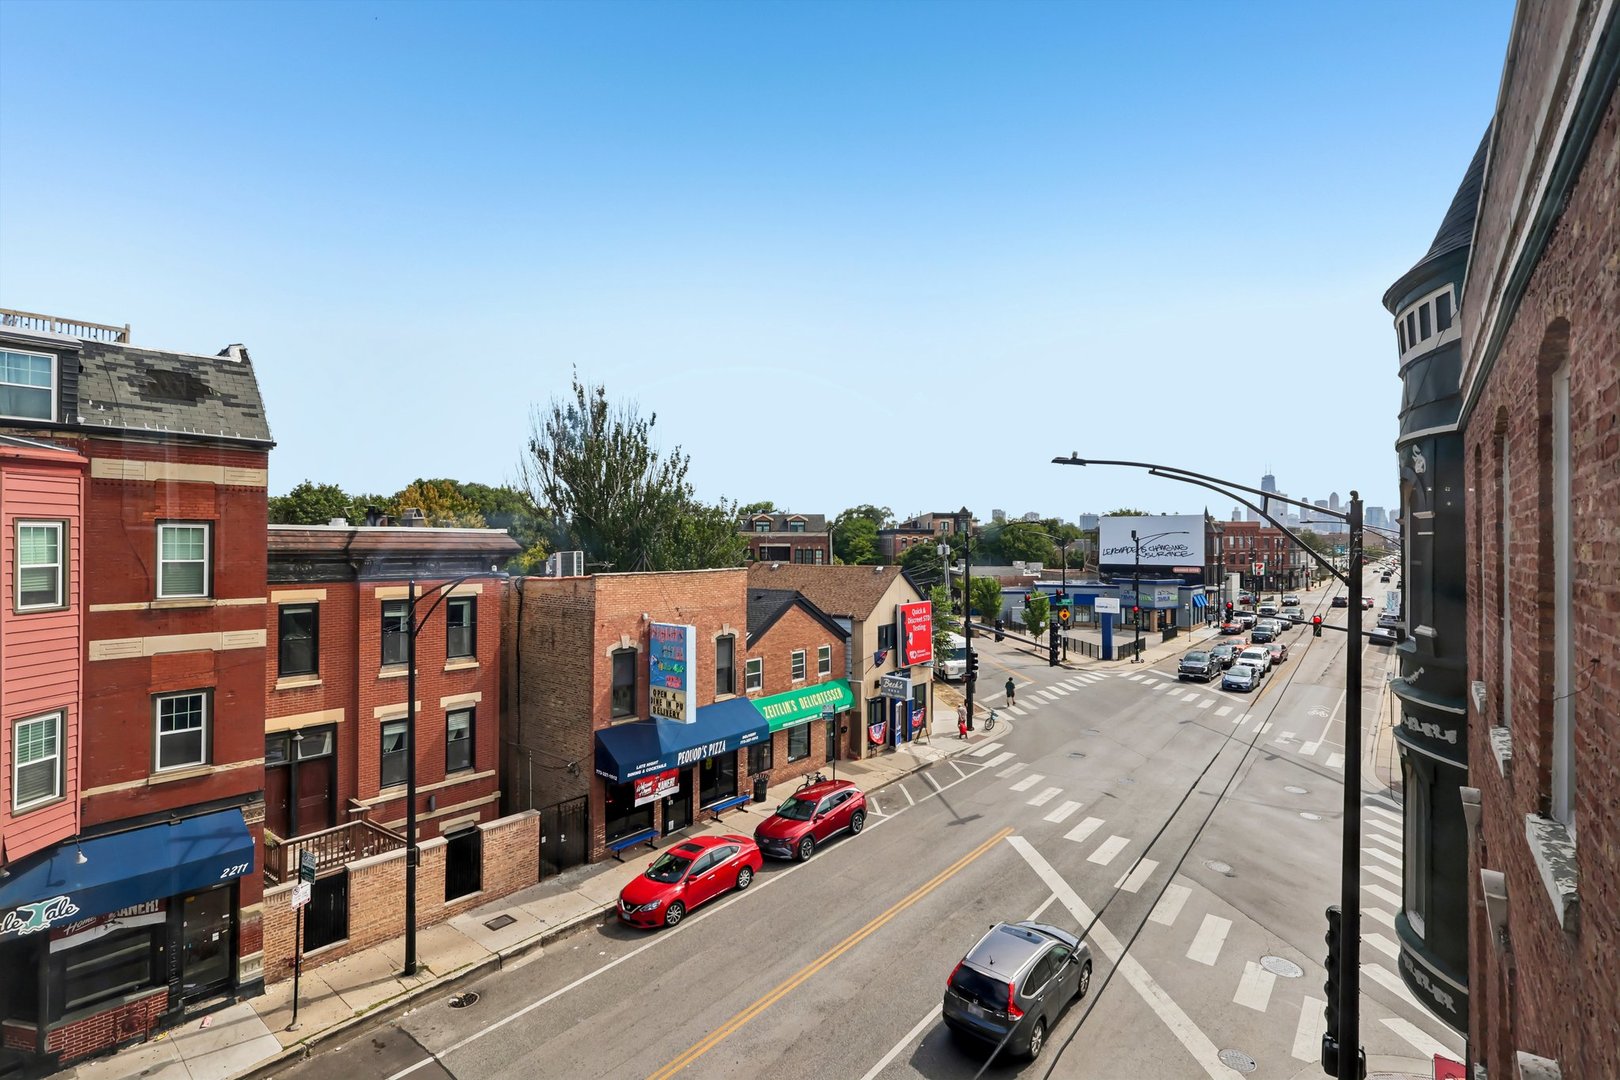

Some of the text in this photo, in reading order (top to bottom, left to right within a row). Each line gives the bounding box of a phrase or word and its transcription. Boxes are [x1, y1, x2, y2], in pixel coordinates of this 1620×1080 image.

[652, 689, 667, 698] OPEN
[763, 699, 798, 719] ZEITLIN'S
[798, 687, 843, 709] DELICATESSEN
[652, 706, 681, 719] DELIVERY
[677, 744, 708, 767] PEQUOD'S
[708, 740, 726, 757] PIZZA
[220, 862, 249, 879] 2211
